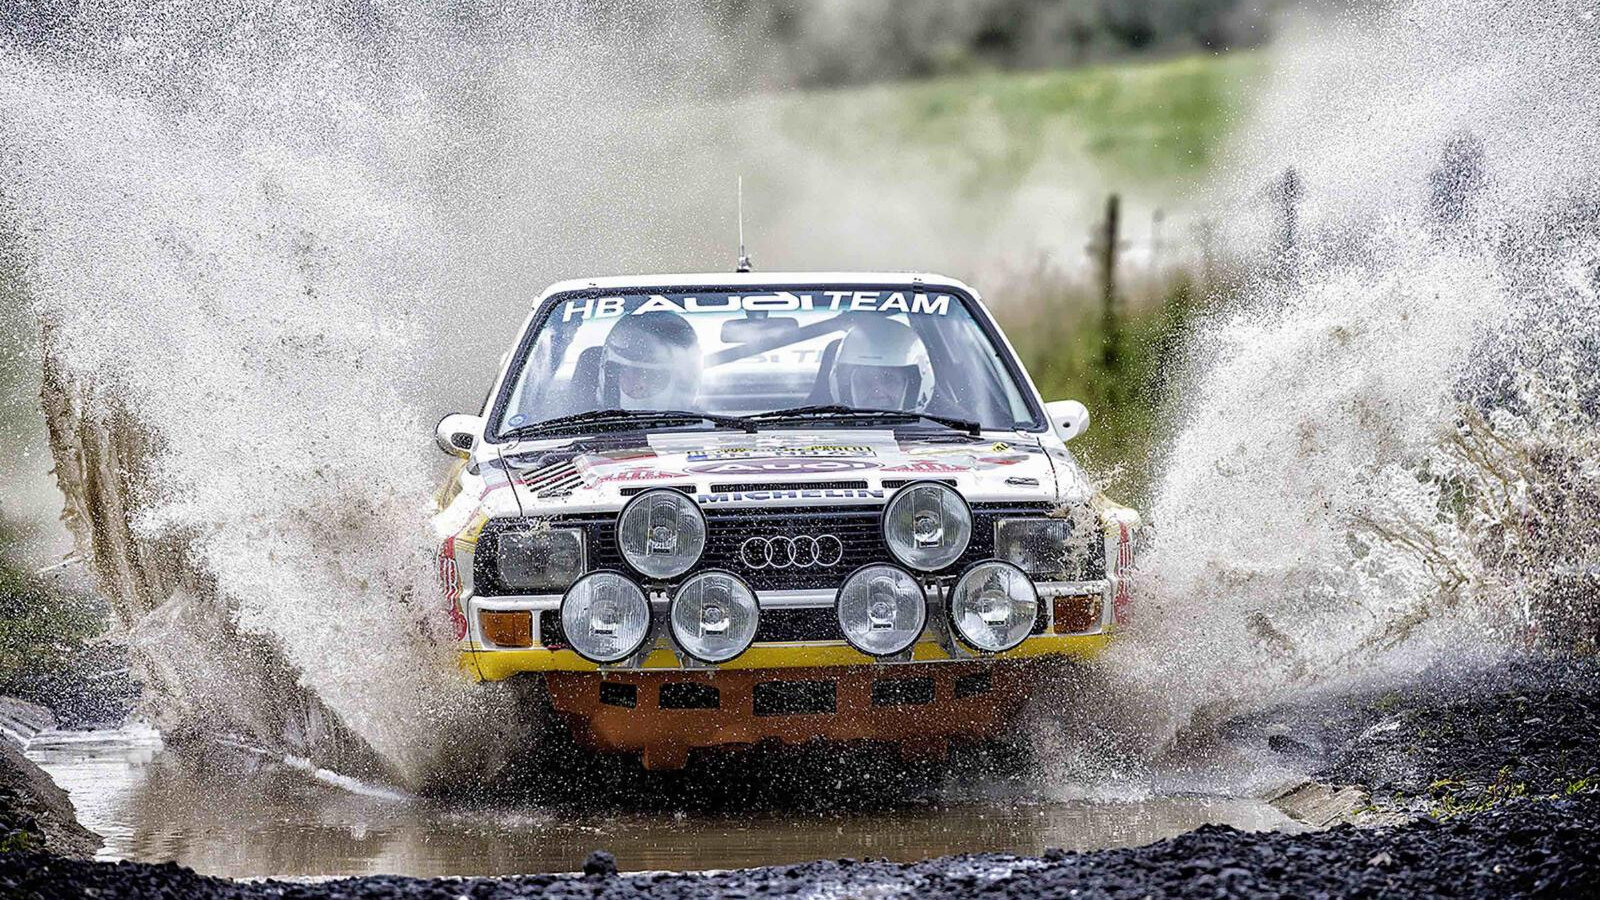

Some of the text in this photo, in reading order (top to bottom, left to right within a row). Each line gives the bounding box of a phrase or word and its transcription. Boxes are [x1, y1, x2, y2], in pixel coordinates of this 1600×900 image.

[562, 297, 624, 321] HB
[820, 291, 951, 315] TEAM
[698, 490, 884, 504] MICHELIN
